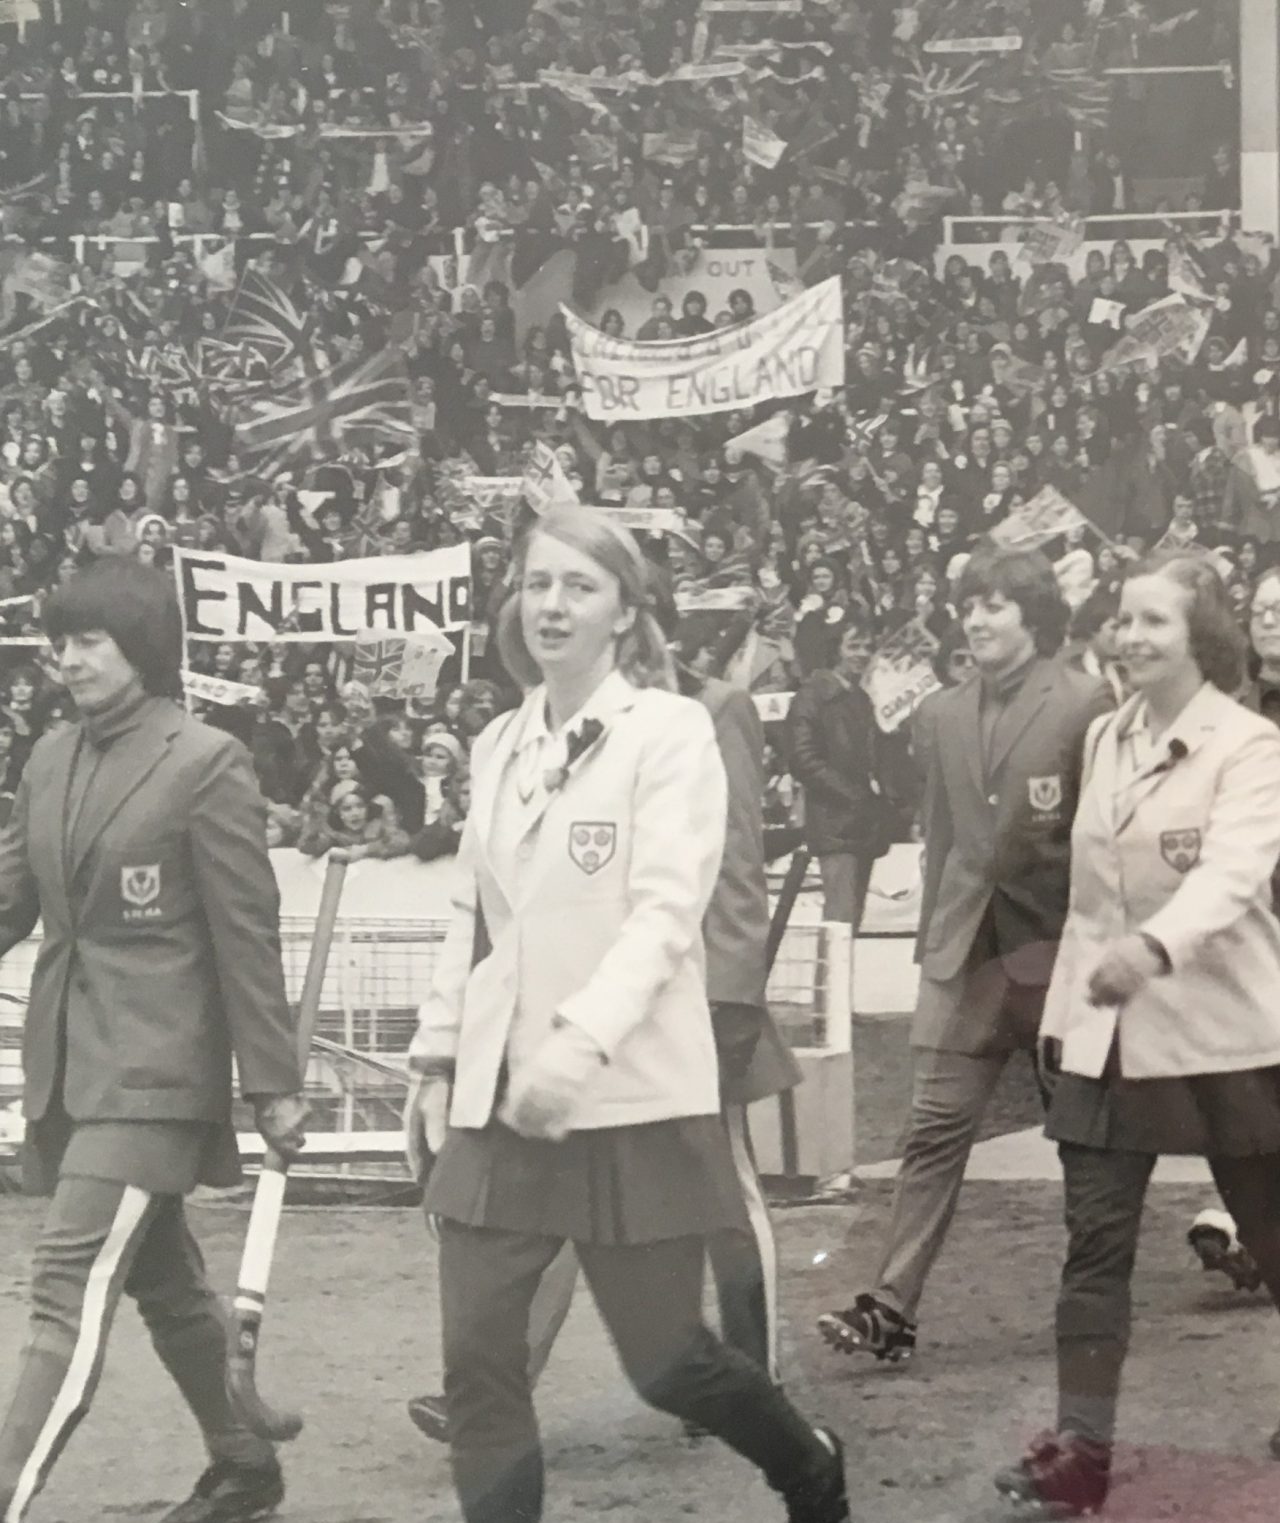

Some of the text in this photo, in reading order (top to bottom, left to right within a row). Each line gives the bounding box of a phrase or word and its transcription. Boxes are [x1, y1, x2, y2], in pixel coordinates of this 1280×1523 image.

[707, 260, 755, 278] OUT
[666, 346, 820, 410] ENGLAND
[181, 557, 471, 635] ENGLAND
